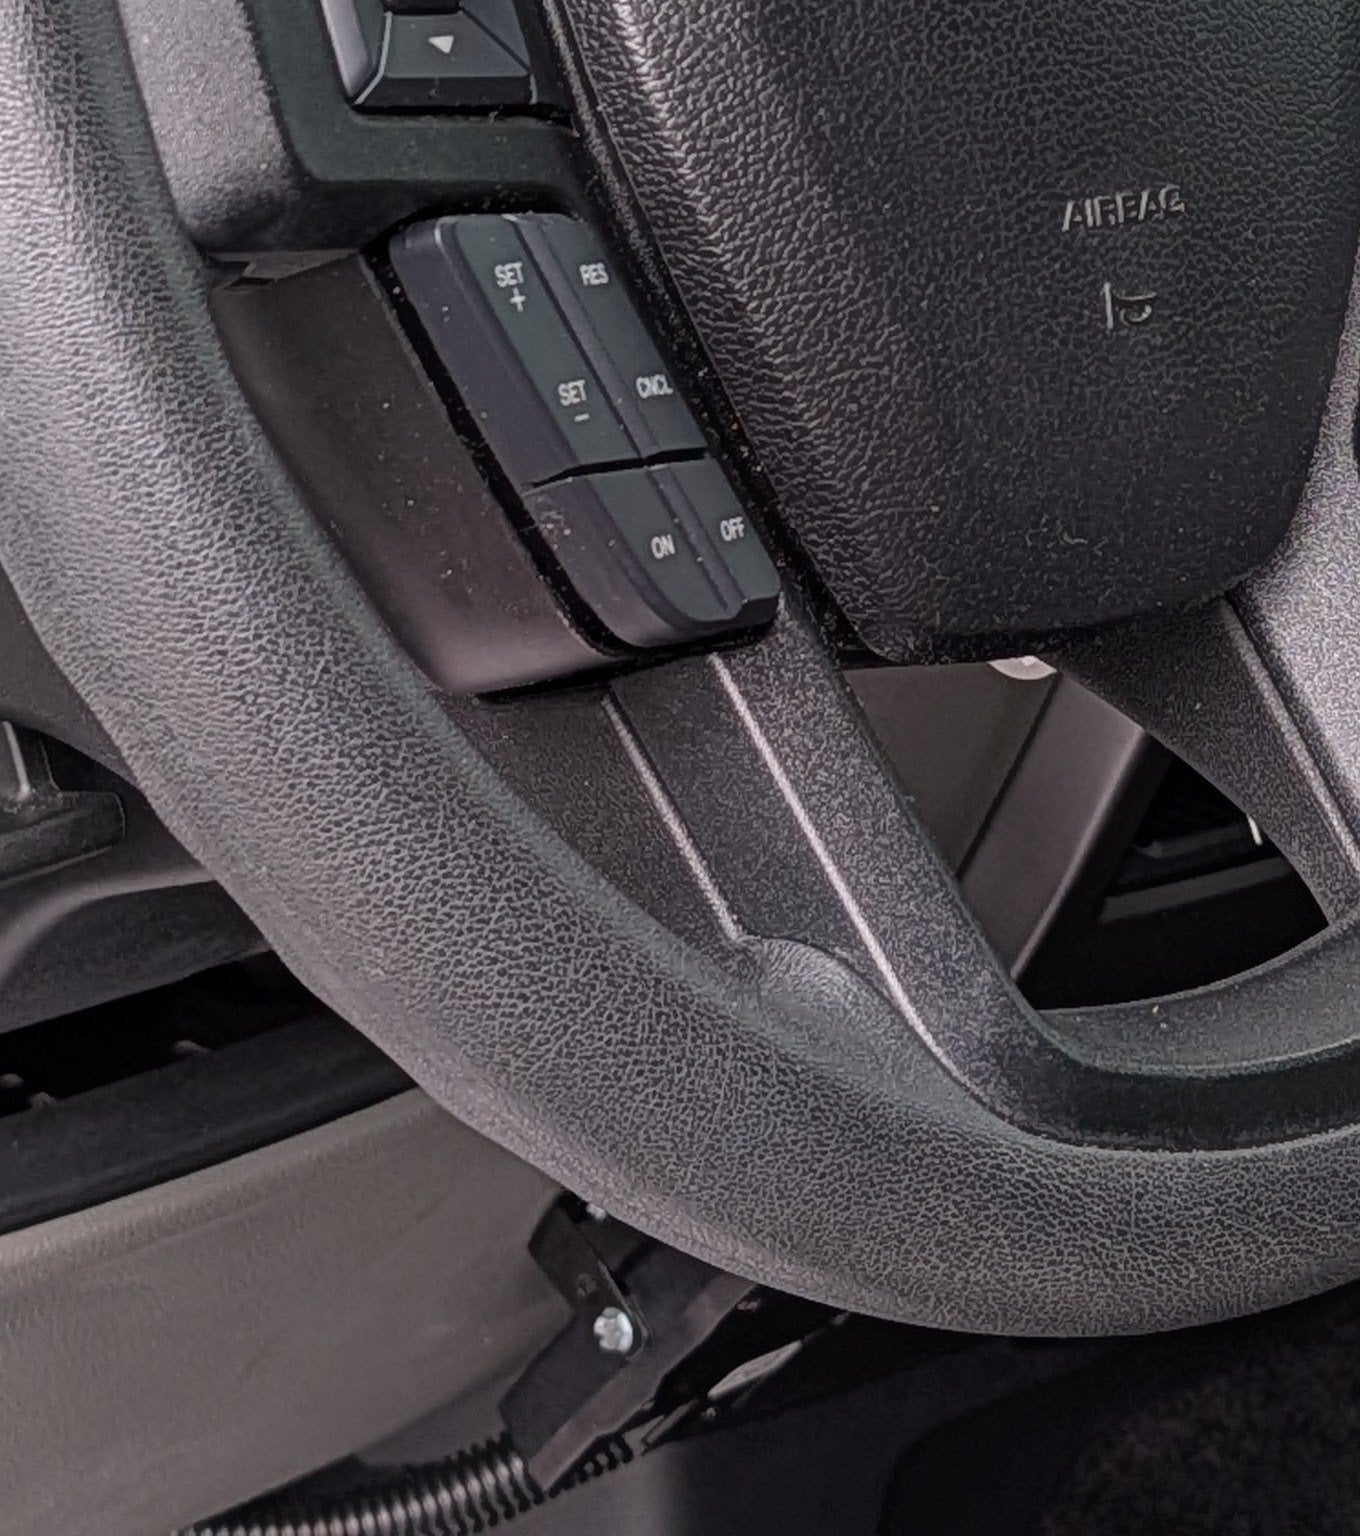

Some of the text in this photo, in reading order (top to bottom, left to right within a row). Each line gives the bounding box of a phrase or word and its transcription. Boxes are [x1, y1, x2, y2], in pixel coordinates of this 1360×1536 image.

[1061, 184, 1185, 232] AIRBAG
[494, 263, 524, 287] SET
[580, 263, 609, 285] RES
[557, 380, 587, 405] SET
[635, 374, 673, 399] CNCL
[720, 517, 745, 540] OFF
[651, 536, 675, 559] ON
